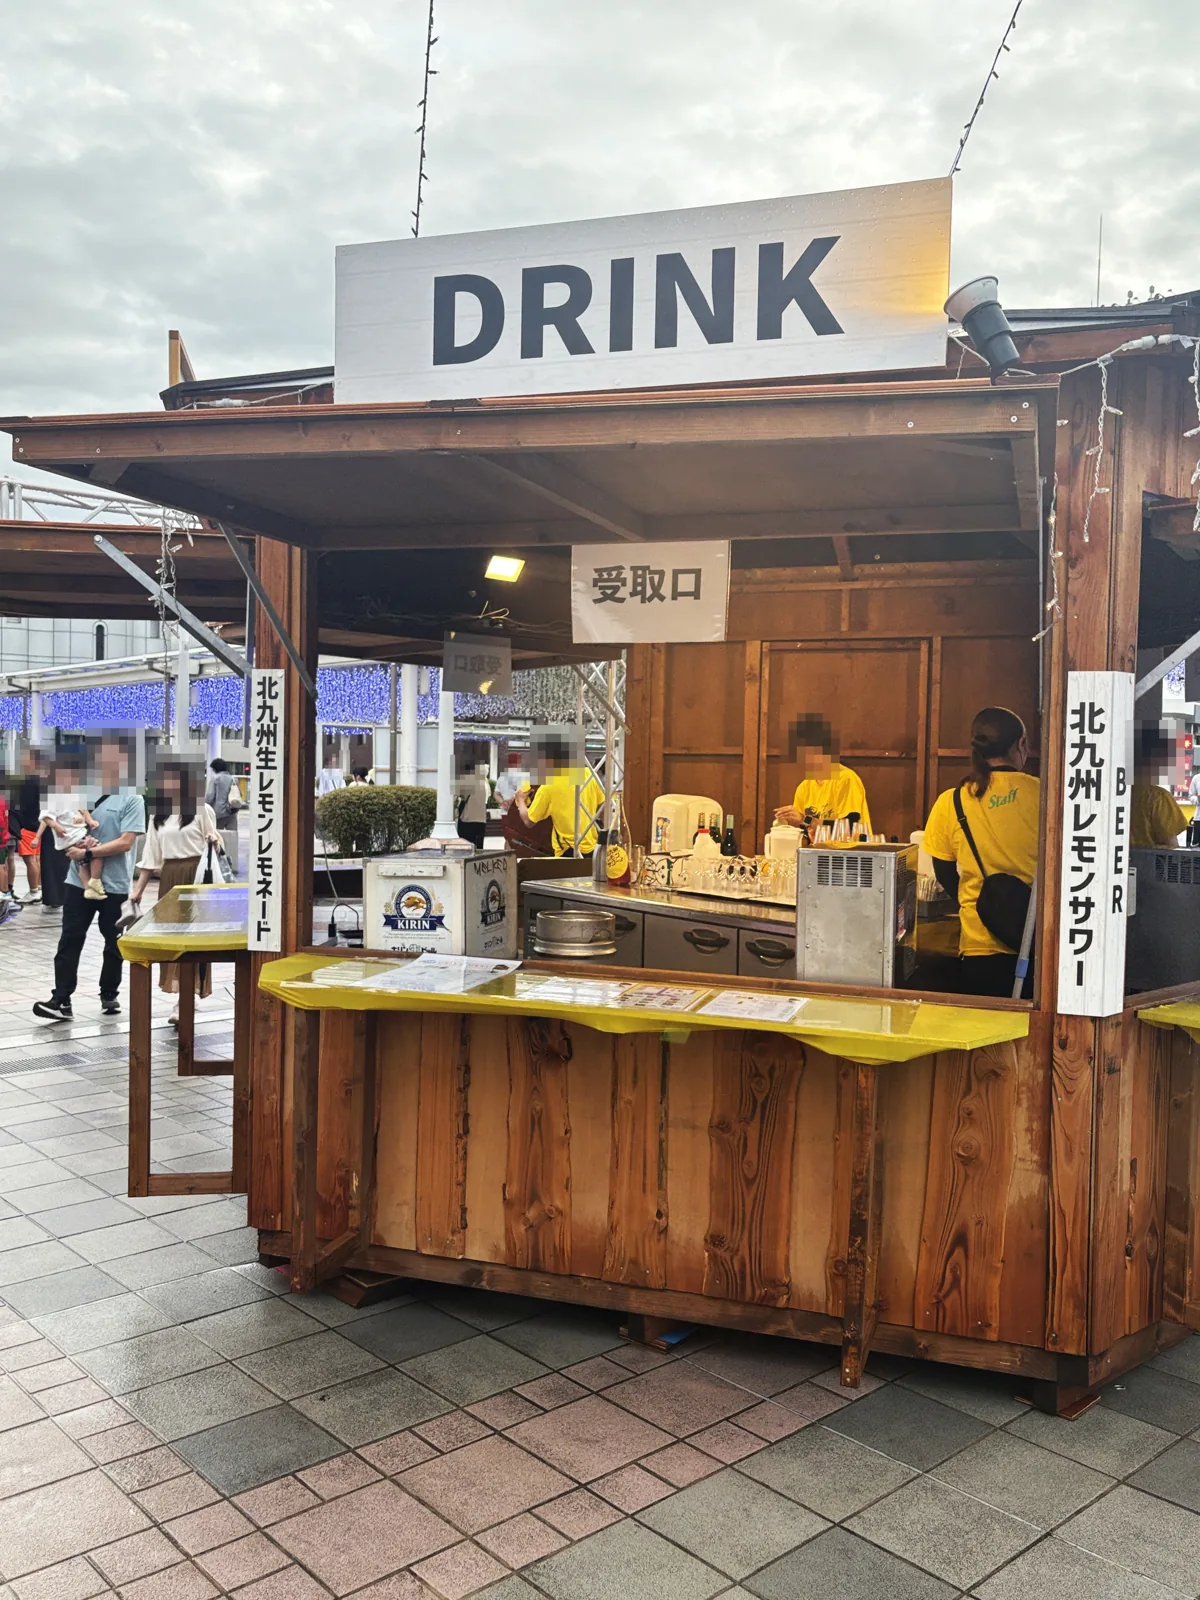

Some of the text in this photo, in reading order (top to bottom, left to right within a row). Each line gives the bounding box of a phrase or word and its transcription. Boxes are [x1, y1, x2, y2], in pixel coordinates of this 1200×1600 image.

[432, 235, 845, 366] DRINK
[592, 564, 702, 604] 受取口
[256, 676, 279, 942] 北九州生レモンレモネード
[988, 787, 1019, 809] Staff
[1068, 702, 1105, 986] 北九州レモンサワー
[1112, 767, 1127, 914] BEER
[397, 919, 430, 930] KIRIN
